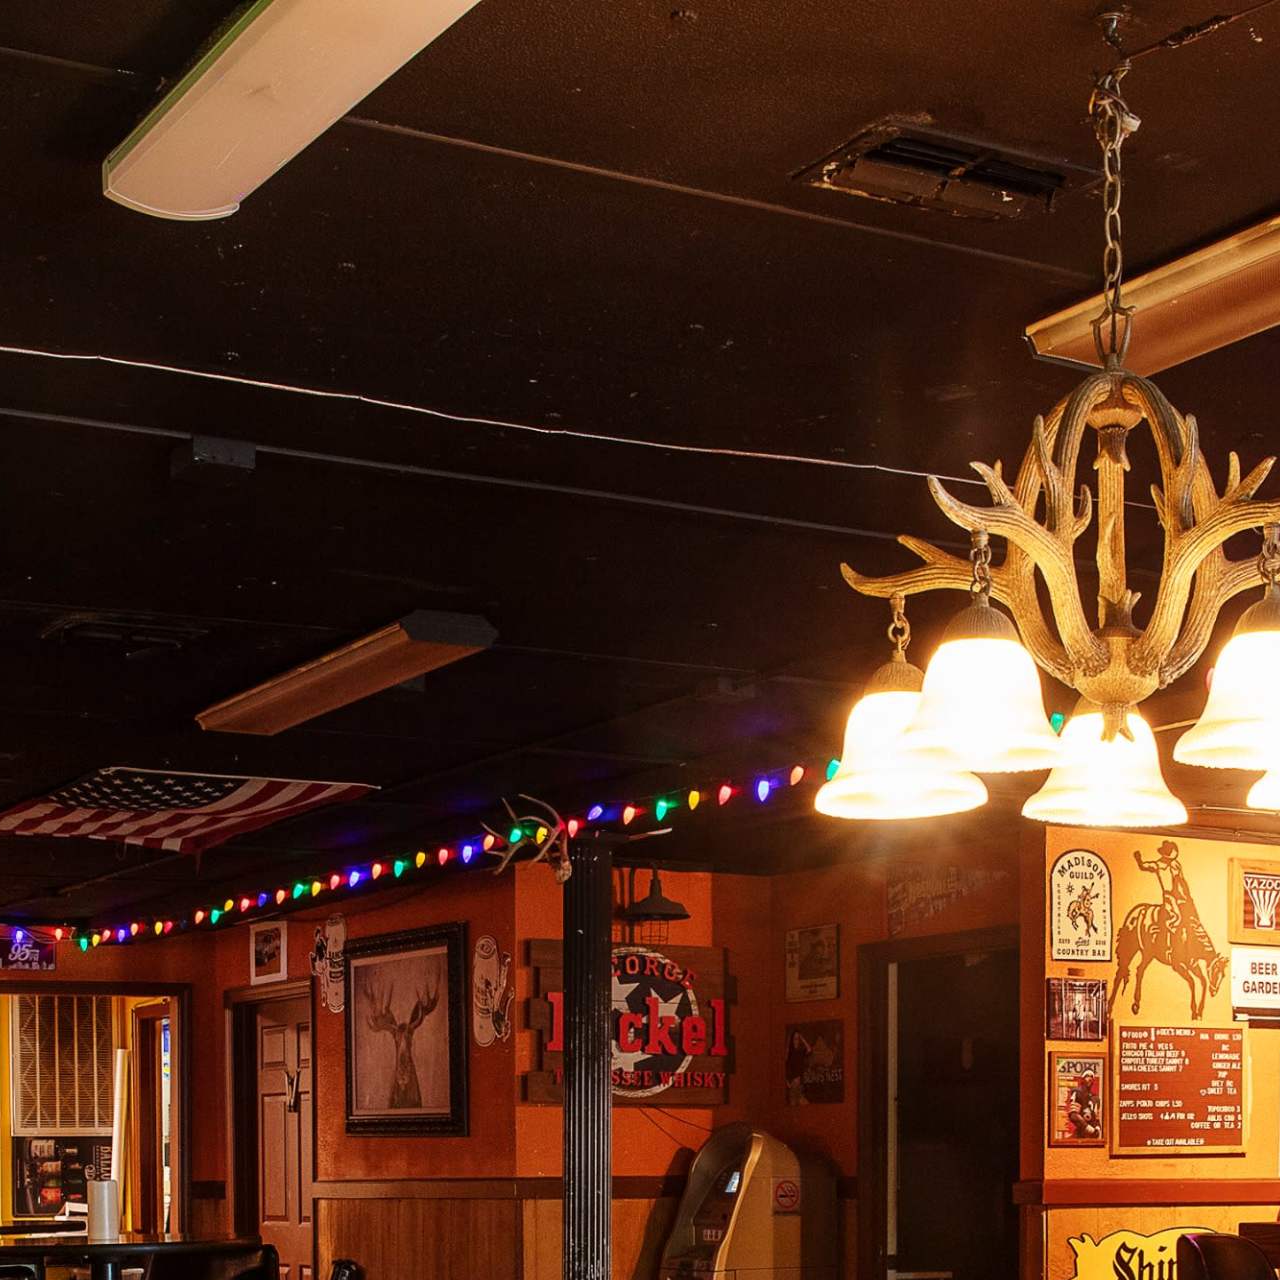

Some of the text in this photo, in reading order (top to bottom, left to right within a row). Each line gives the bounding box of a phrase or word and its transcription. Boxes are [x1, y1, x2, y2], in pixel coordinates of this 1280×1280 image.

[1057, 856, 1105, 880] MADISON
[1069, 871, 1094, 880] GUILD
[1056, 948, 1106, 957] COUNTRY BAR
[611, 956, 697, 990] EORGE
[1251, 962, 1278, 976] BEER
[1058, 1061, 1100, 1074] SPORT
[660, 1071, 726, 1088] WHISKY
